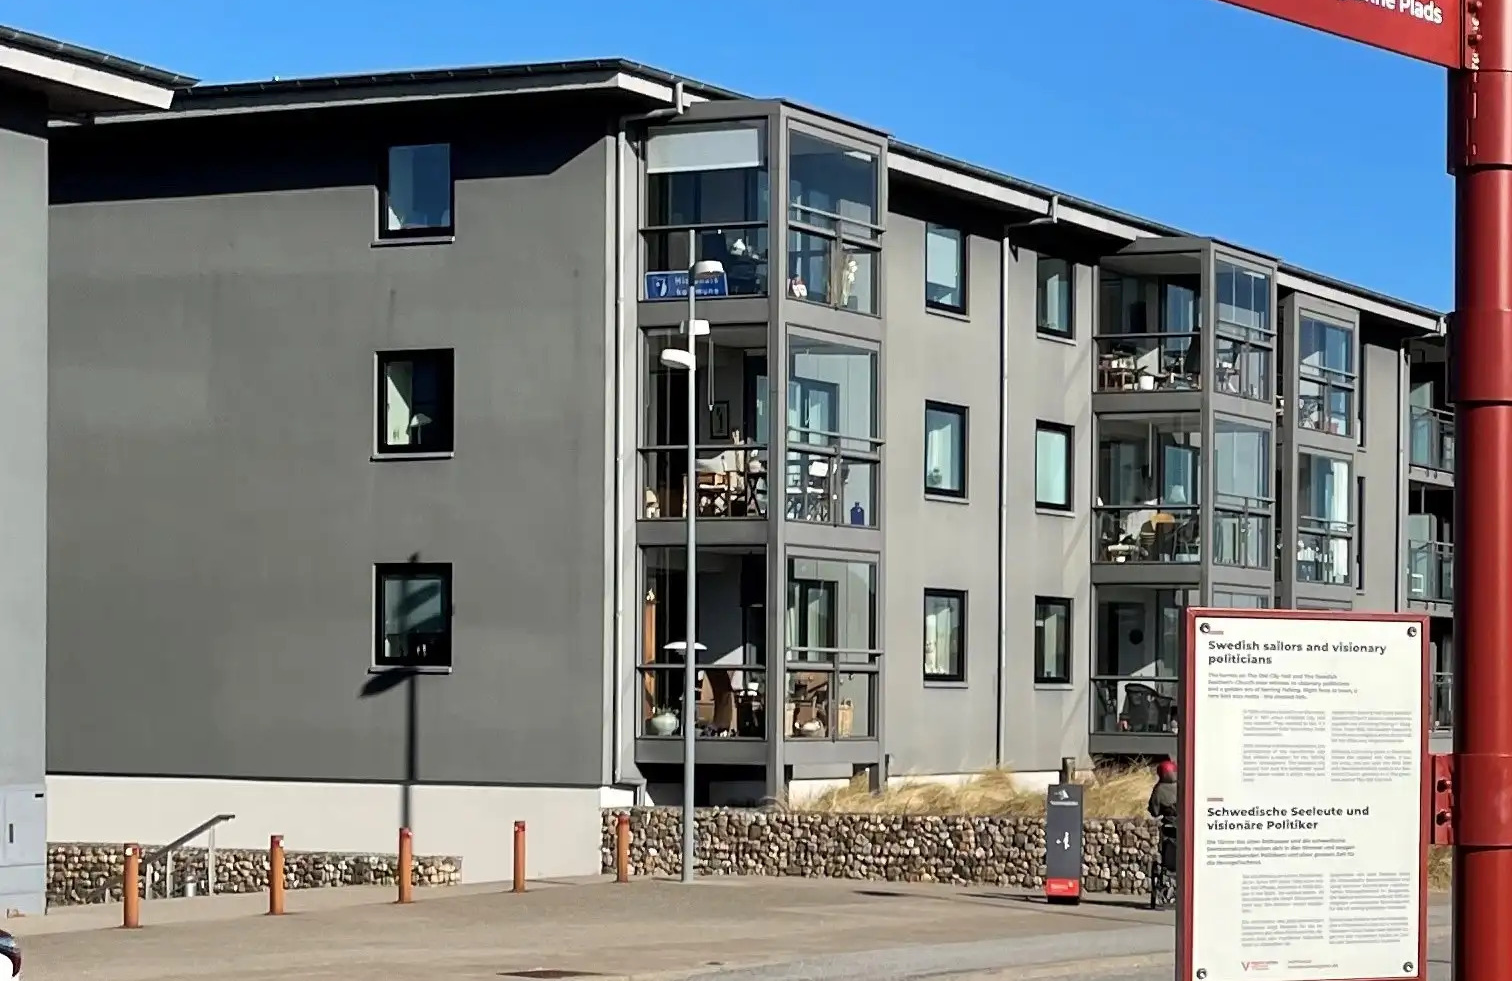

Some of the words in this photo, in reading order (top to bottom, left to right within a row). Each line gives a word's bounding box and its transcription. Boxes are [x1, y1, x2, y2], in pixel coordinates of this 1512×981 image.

[1207, 640, 1260, 652] Swedish
[1263, 640, 1303, 652] sailors
[1306, 642, 1329, 652] and
[1332, 641, 1387, 655] visionary
[1207, 653, 1273, 665] politicians
[1206, 806, 1288, 817] Schwedische
[1291, 806, 1344, 817] Seeleute
[1346, 806, 1370, 816] und
[1207, 819, 1264, 830] visionäre
[1266, 819, 1319, 830] Politiker
